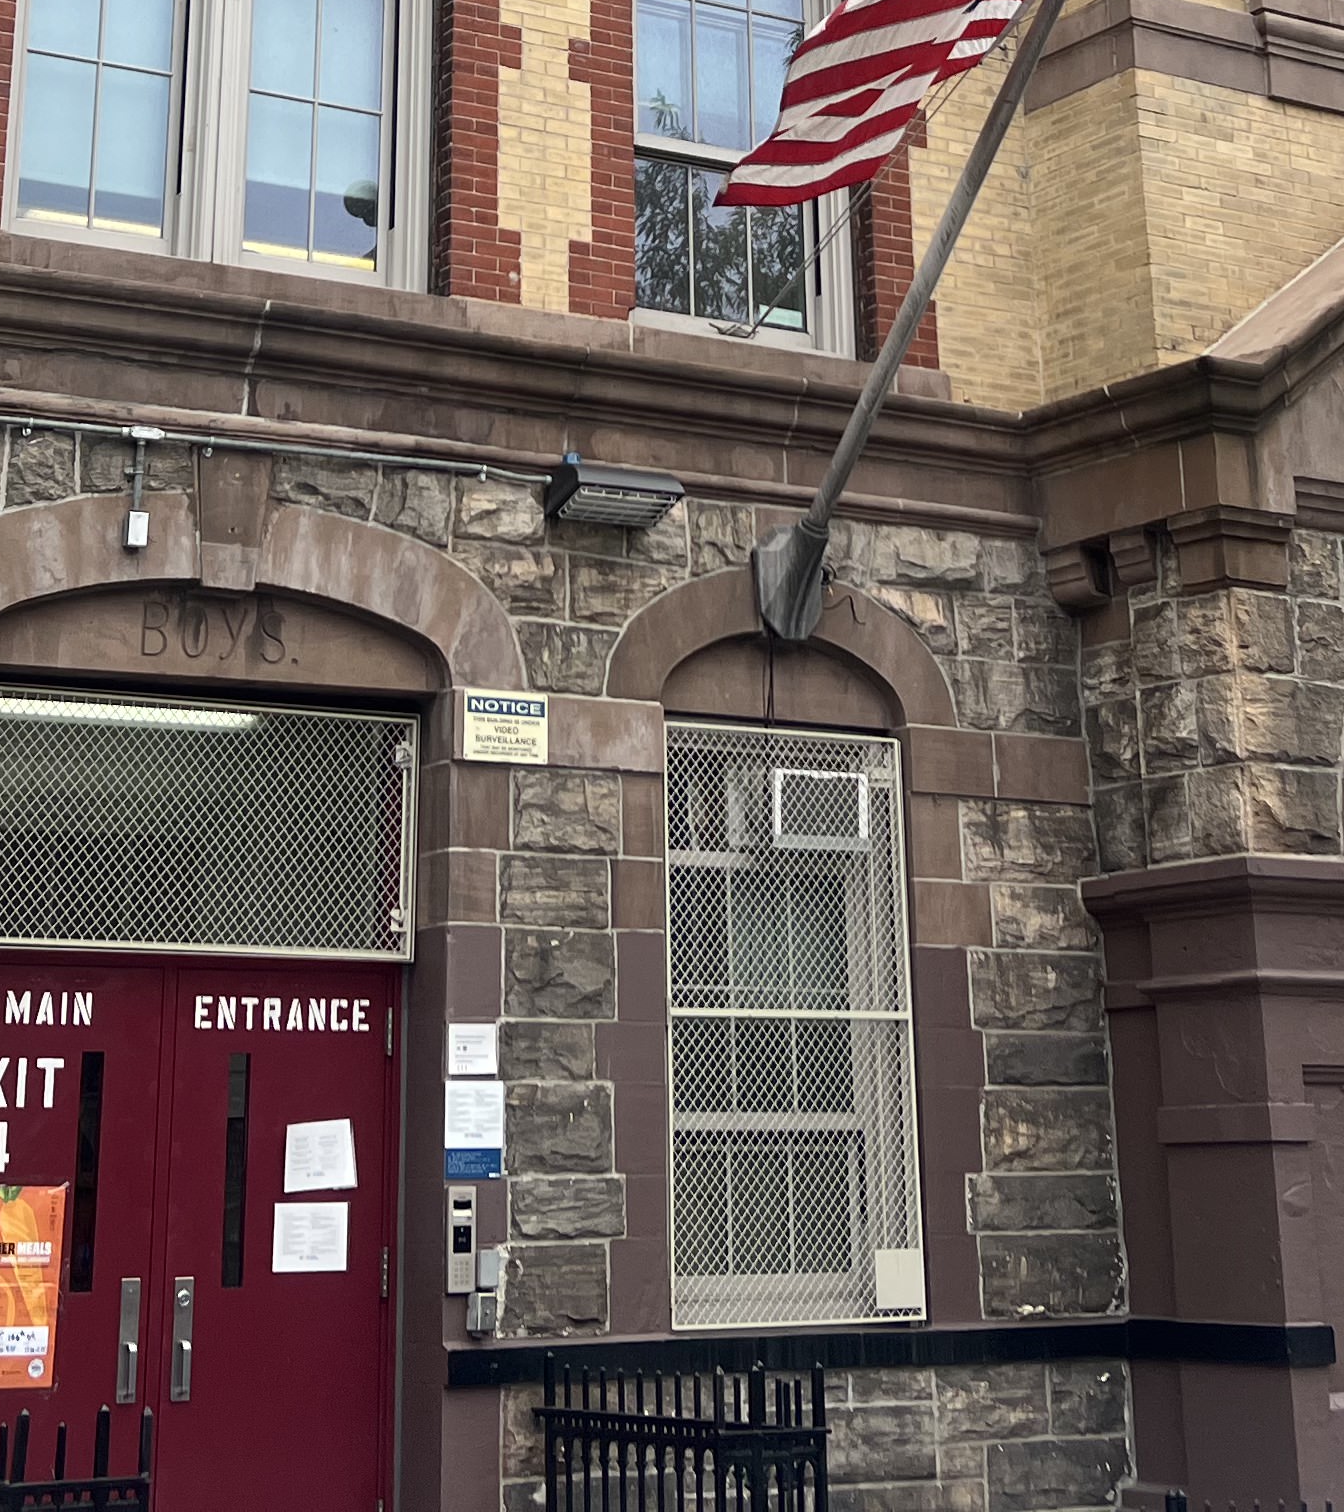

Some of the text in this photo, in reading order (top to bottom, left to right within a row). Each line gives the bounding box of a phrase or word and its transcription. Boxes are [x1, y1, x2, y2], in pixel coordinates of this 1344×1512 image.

[470, 698, 542, 715] NOTICE
[494, 726, 519, 735] VIDEO
[475, 734, 537, 746] SURVEILLANCE
[5, 990, 370, 1032] MAIN ENTRANCE
[17, 1242, 52, 1256] MEALS
